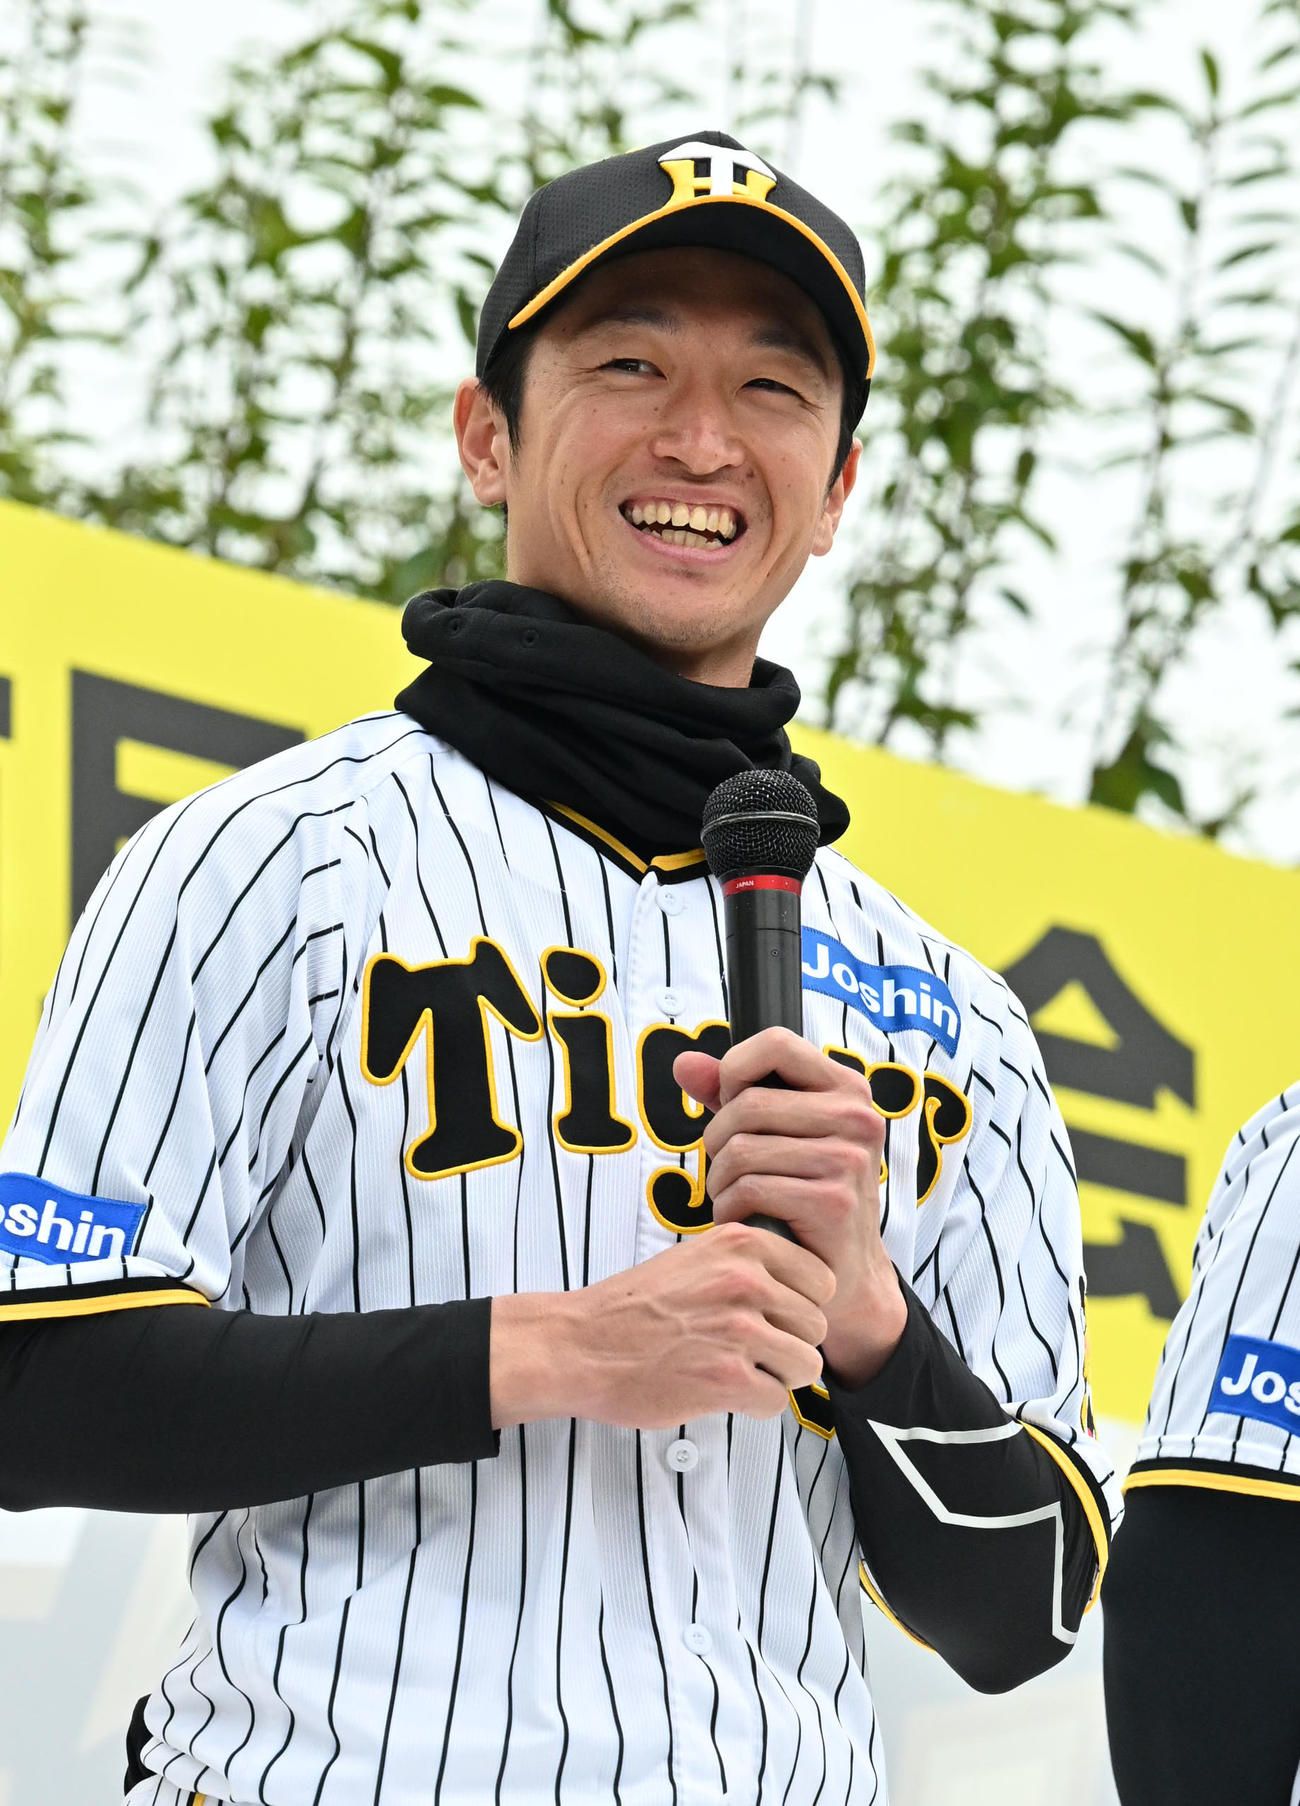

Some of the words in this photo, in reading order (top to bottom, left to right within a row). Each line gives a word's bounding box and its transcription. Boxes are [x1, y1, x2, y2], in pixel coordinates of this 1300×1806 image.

[735, 880, 754, 889] JAPAN
[802, 943, 959, 1040] Joshin
[361, 935, 974, 1234] Tigrs
[0, 1199, 126, 1259] shin
